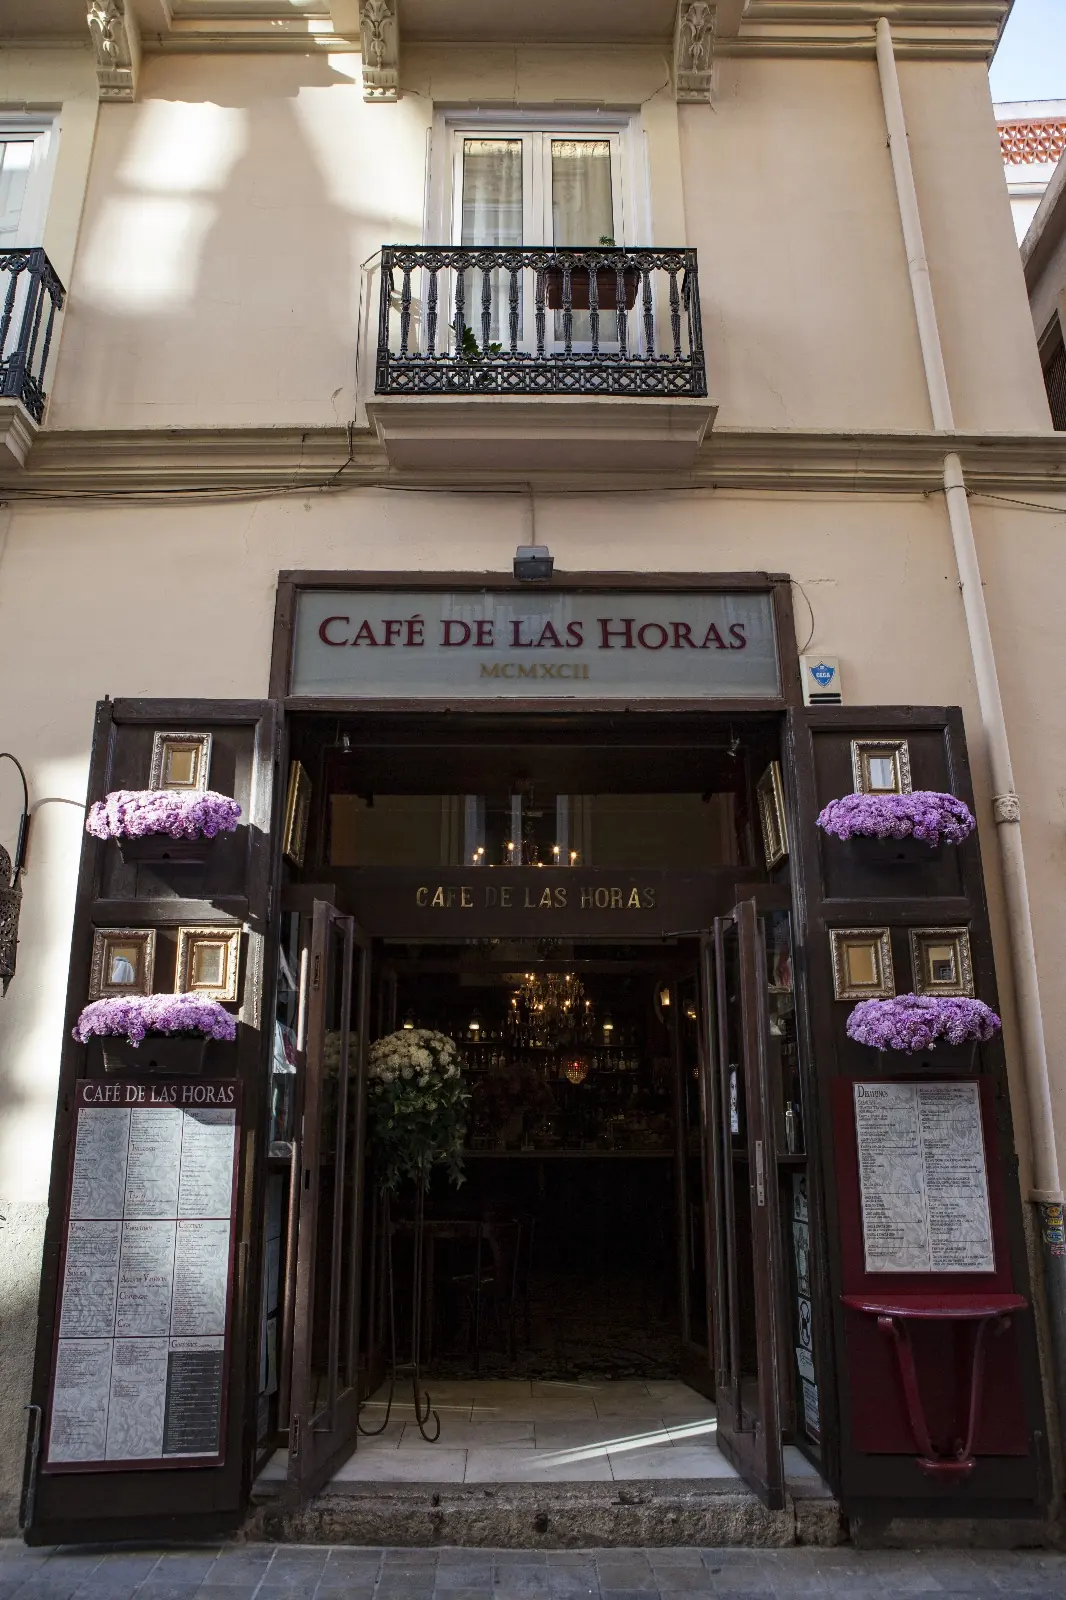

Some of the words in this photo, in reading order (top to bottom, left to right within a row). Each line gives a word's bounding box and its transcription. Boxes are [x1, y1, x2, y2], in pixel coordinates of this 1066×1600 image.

[318, 614, 426, 648] CAFÉ
[440, 620, 494, 647] DE
[508, 620, 584, 650] LAS
[597, 618, 747, 651] HORAS
[480, 662, 590, 680] MCMXCII
[485, 886, 512, 908] DE
[523, 886, 568, 909] LAS
[580, 886, 657, 909] HORAS
[83, 1083, 120, 1102] CAFÉ
[125, 1085, 146, 1102] DE
[150, 1085, 178, 1102] LAS
[182, 1085, 234, 1103] HORAS
